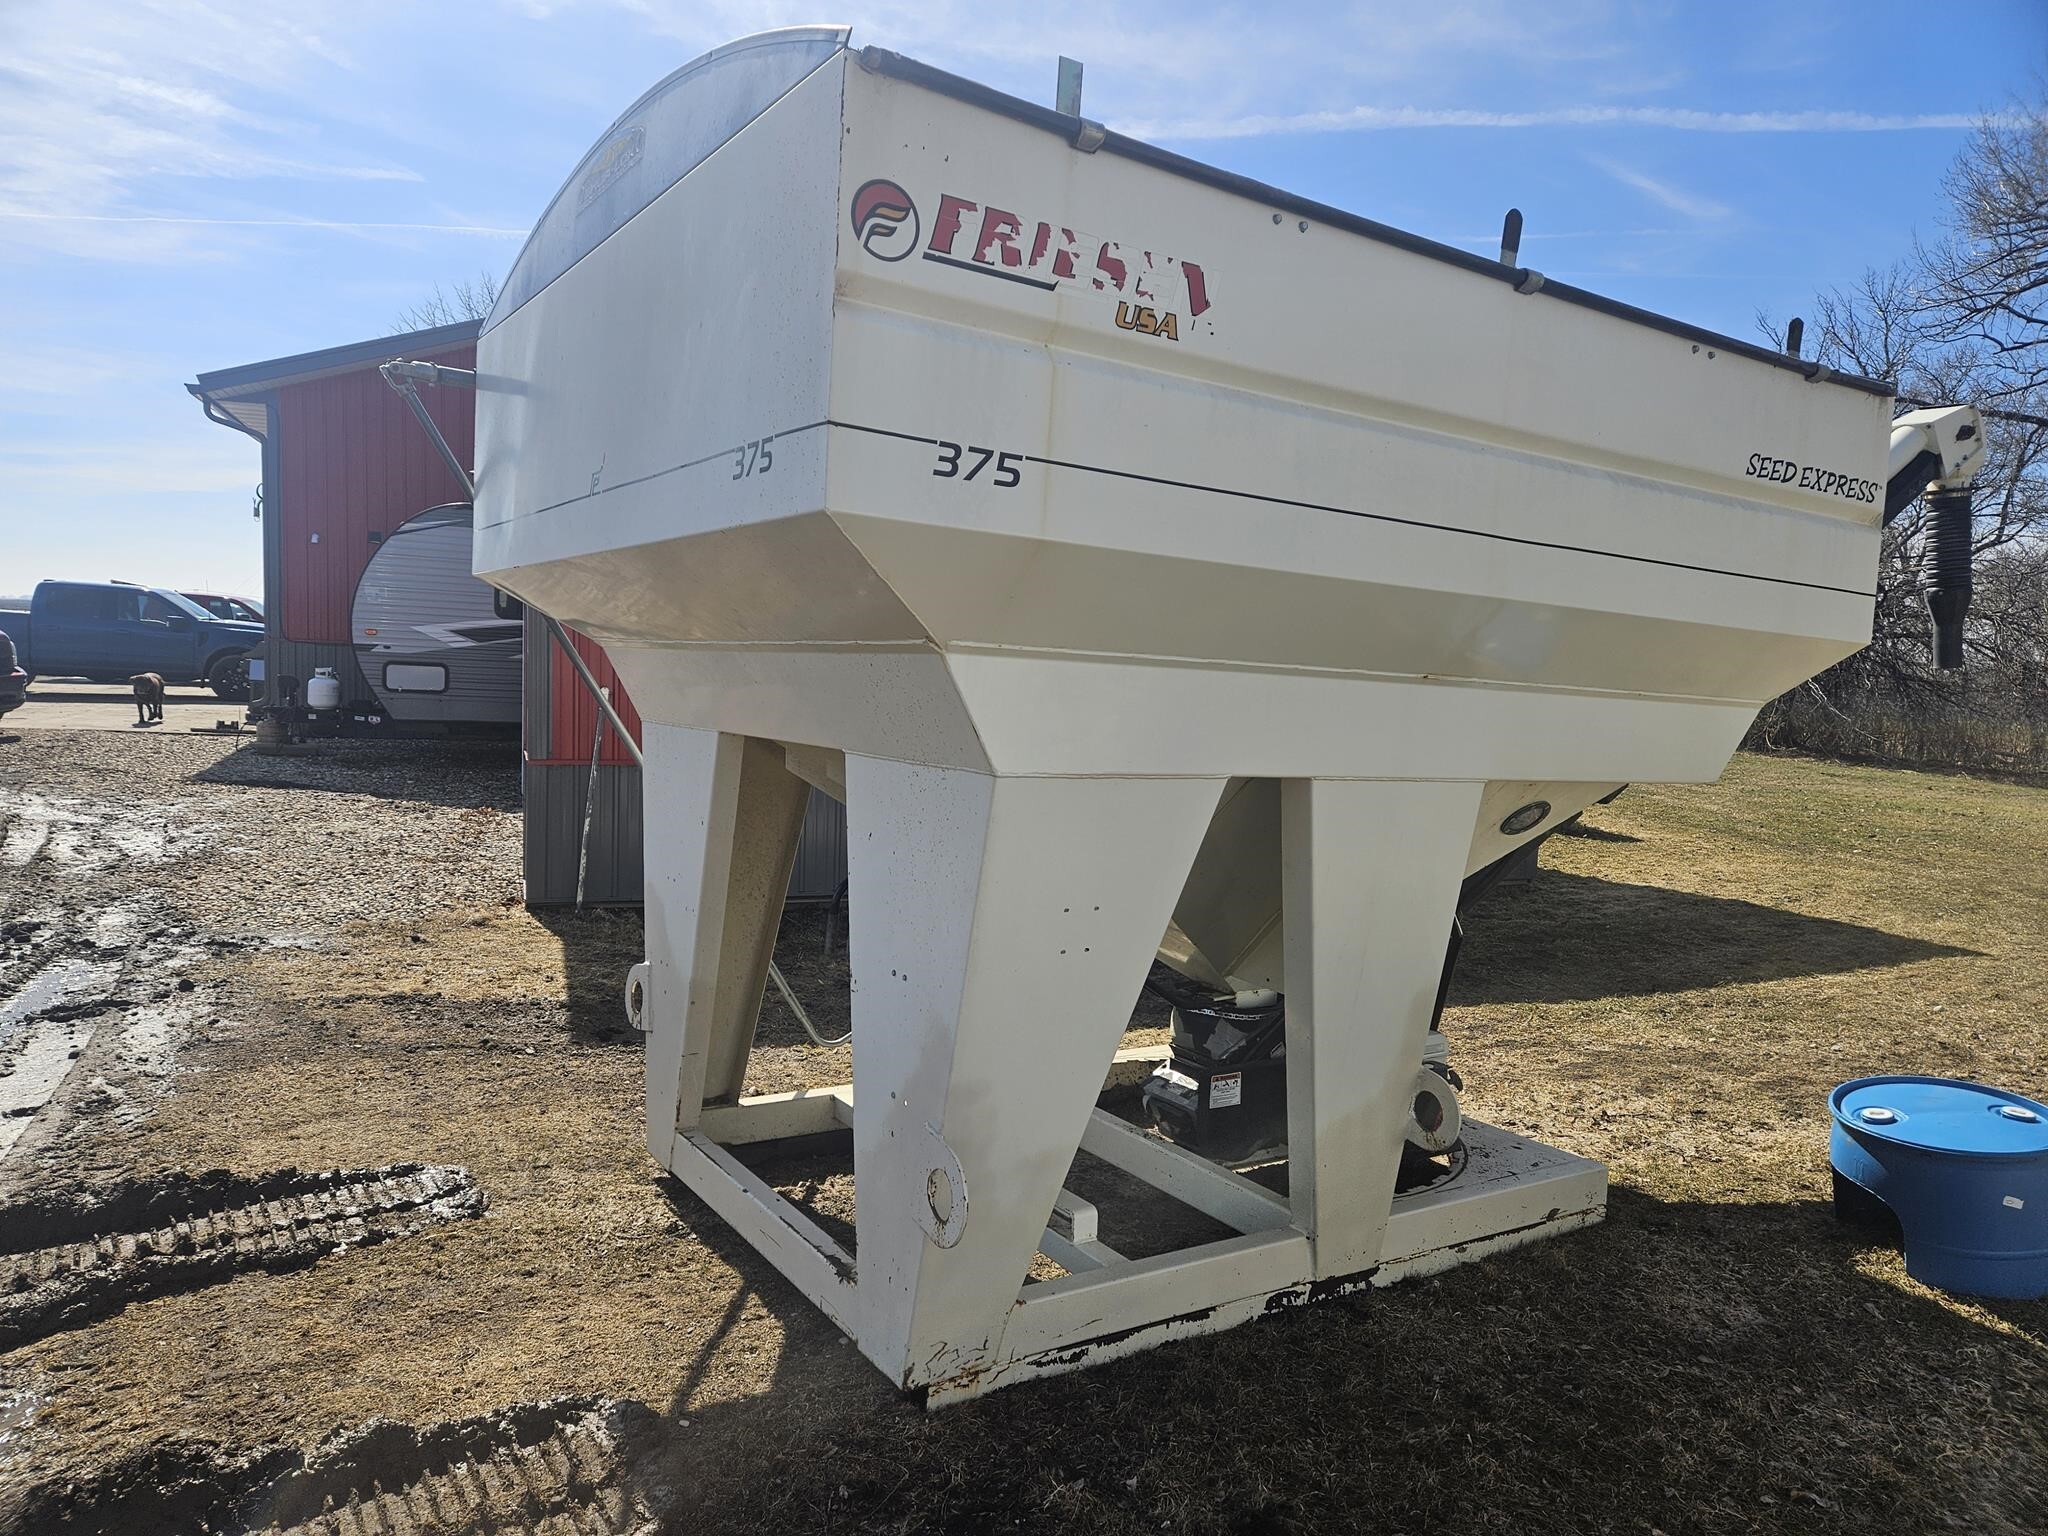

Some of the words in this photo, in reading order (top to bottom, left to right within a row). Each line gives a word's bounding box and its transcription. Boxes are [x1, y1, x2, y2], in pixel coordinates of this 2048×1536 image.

[1116, 301, 1178, 341] USA
[732, 436, 774, 480] 375
[933, 440, 1024, 488] 375
[1746, 453, 1797, 483] SEED
[1798, 467, 1879, 503] EXPRESS
